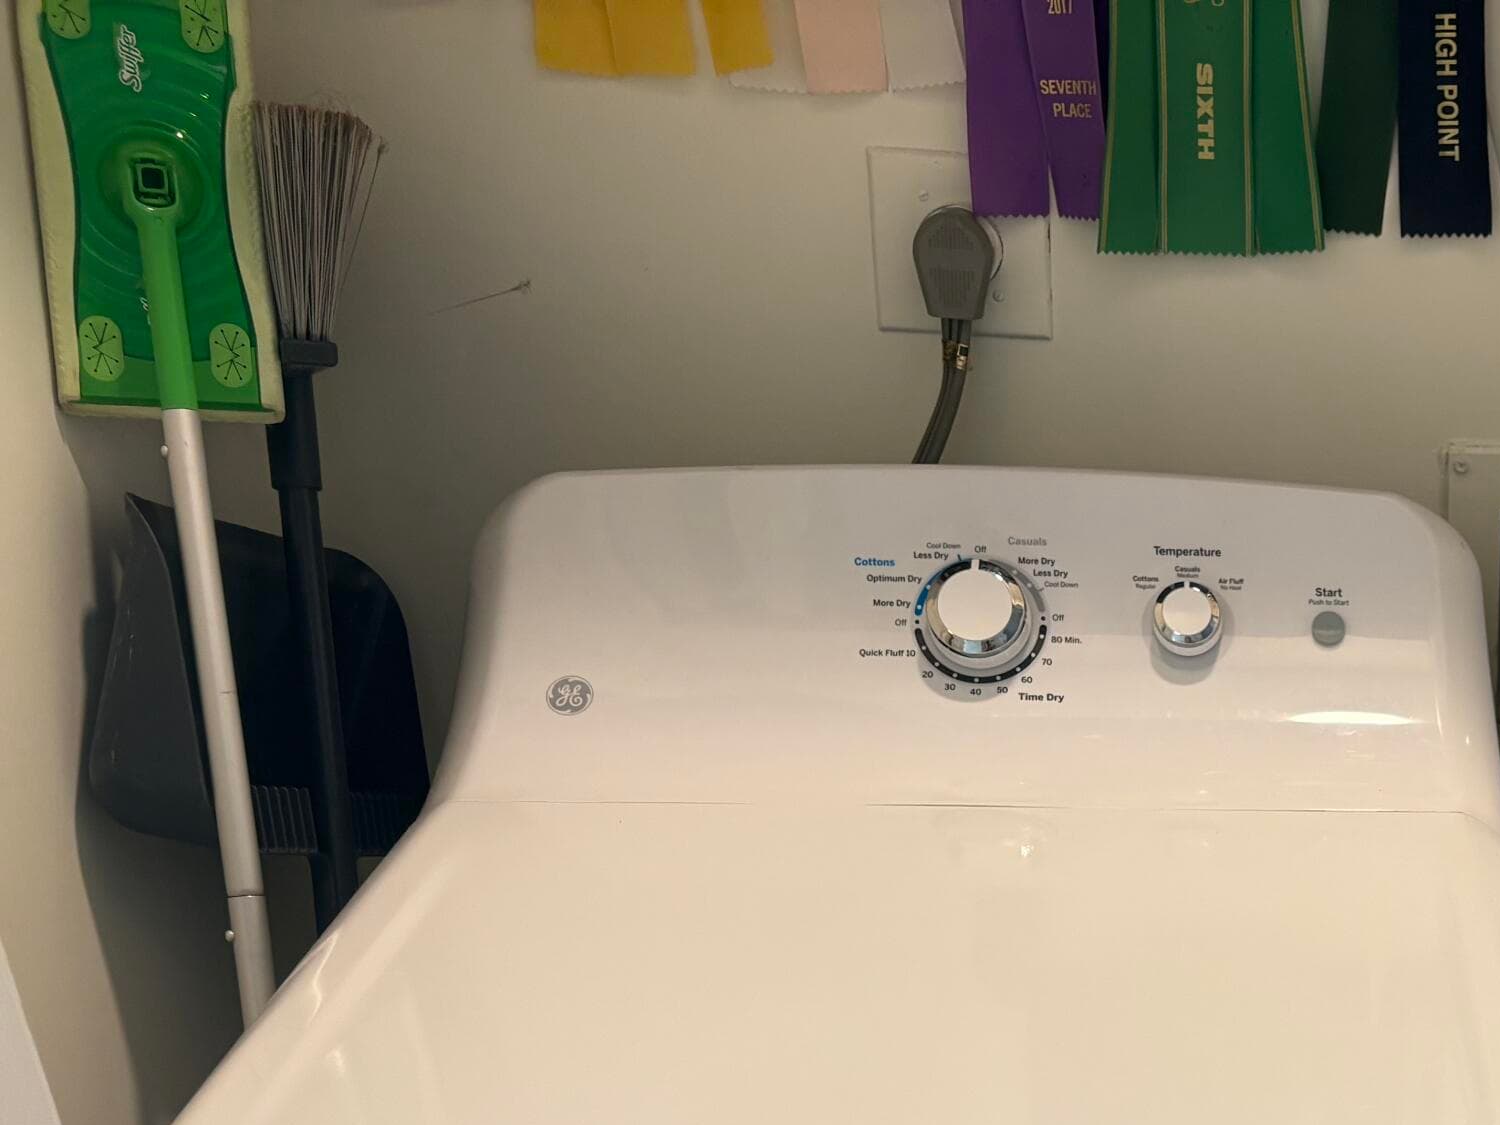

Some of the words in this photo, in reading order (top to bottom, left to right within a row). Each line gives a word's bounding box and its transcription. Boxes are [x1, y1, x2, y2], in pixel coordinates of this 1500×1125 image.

[1435, 13, 1458, 76] HIGH
[1040, 80, 1097, 95] SEVENTH
[1053, 102, 1092, 118] PLACE
[1196, 63, 1214, 160] SIXTH
[1436, 84, 1460, 161] POINT
[1008, 536, 1047, 547] Casuals
[974, 545, 987, 553] Off
[1154, 546, 1222, 557] Temperature
[913, 551, 932, 559] Less
[934, 551, 949, 561] Dry
[854, 557, 896, 567] Cottons
[1018, 556, 1039, 565] More
[1041, 557, 1056, 567] Dry
[866, 574, 906, 583] Optimum
[907, 575, 922, 584] Dry
[1033, 569, 1052, 577] Less
[1053, 570, 1069, 579] Dry
[1315, 587, 1343, 597] Start
[896, 600, 911, 608] Dry
[1051, 636, 1063, 644] 80
[1064, 636, 1083, 644] Min.
[859, 648, 883, 658] Quick
[885, 649, 905, 657] Fluff
[906, 649, 916, 657] 10
[1042, 658, 1053, 666] 70
[1021, 676, 1033, 684] 60
[970, 688, 982, 696] 40
[997, 686, 1009, 694] 50
[1019, 692, 1044, 702] Time
[1046, 693, 1065, 704] Dry
